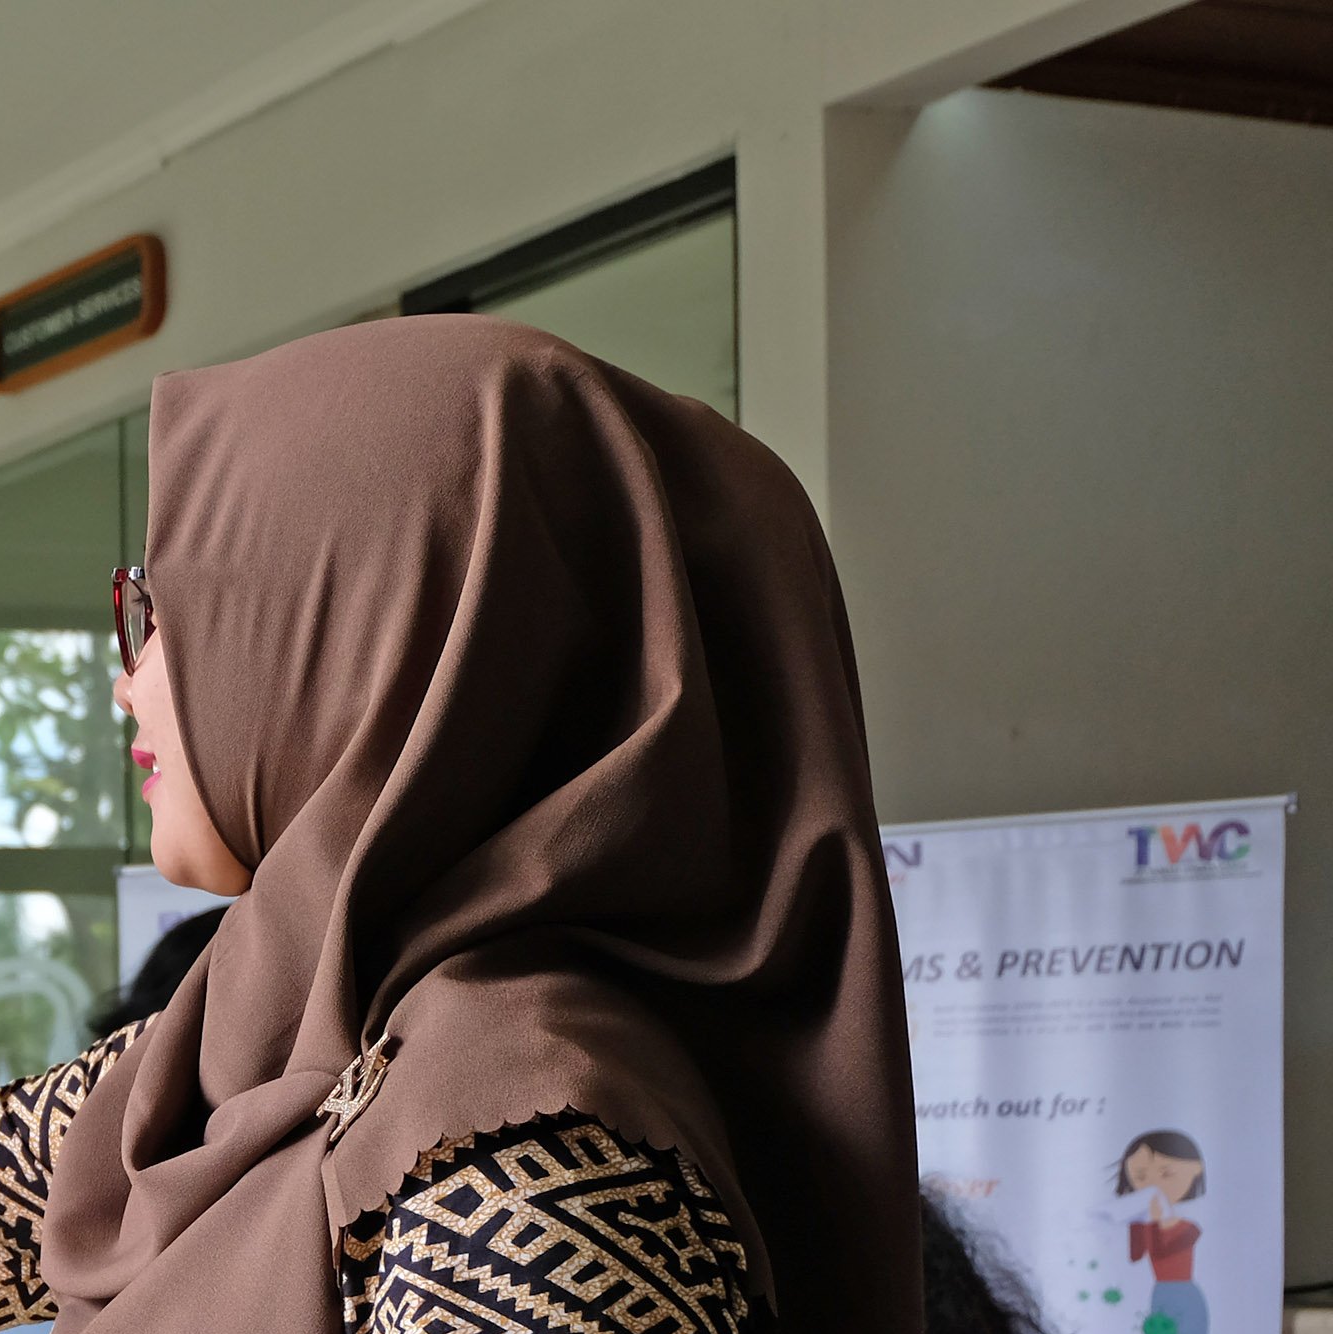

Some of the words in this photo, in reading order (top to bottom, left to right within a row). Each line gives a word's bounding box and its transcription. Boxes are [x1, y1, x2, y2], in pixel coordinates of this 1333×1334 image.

[1127, 819, 1251, 864] TWC
[955, 952, 983, 982] &
[995, 938, 1245, 978] PREVENTION
[996, 1097, 1043, 1117] out
[1049, 1092, 1090, 1121] for
